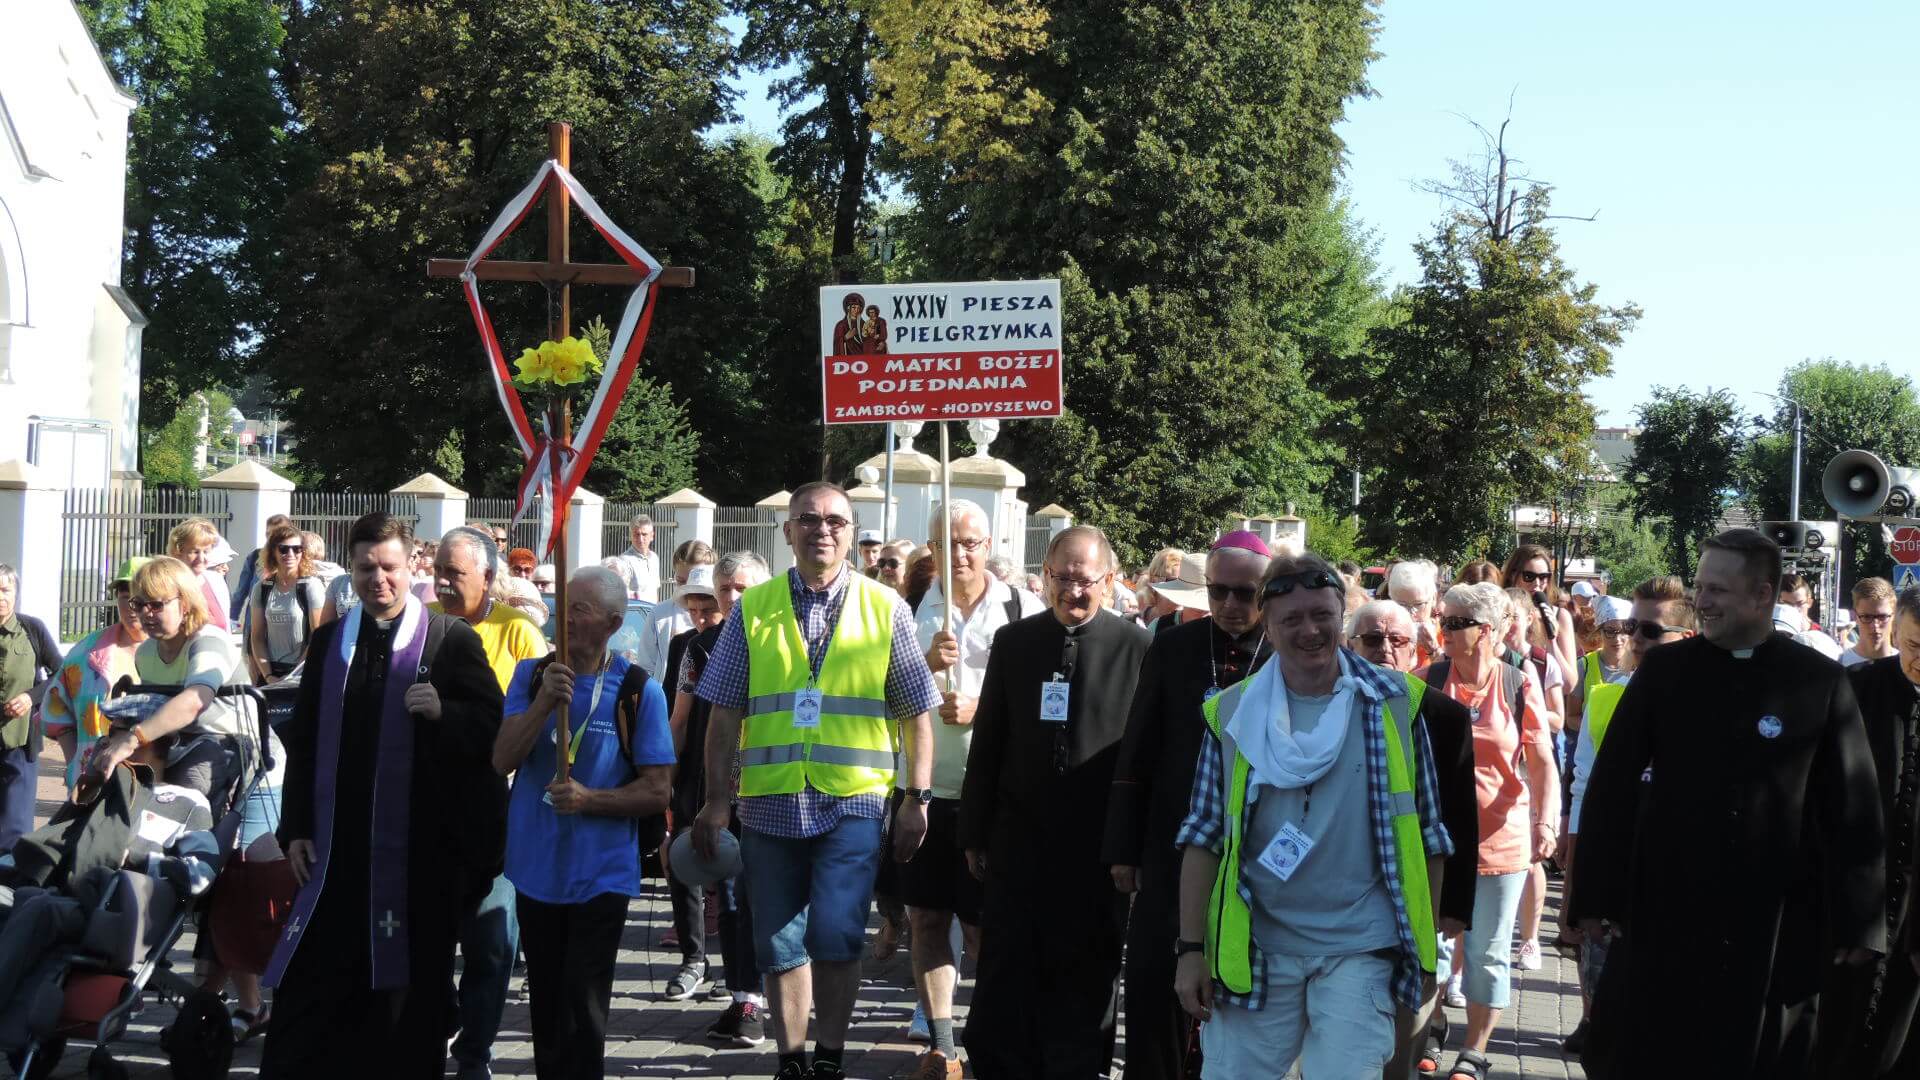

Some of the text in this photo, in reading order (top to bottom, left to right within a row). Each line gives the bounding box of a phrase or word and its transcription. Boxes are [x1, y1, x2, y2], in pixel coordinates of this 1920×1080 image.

[893, 294, 1054, 320] XXXIV PIESZA
[895, 322, 1053, 342] PIELGRZYMKA
[832, 352, 1054, 375] DO MATKI BOŻEJ
[858, 375, 1027, 394] POJEDNANIA
[835, 401, 926, 418] ZAMBRÓW
[943, 400, 1053, 414] HODYSZEWO
